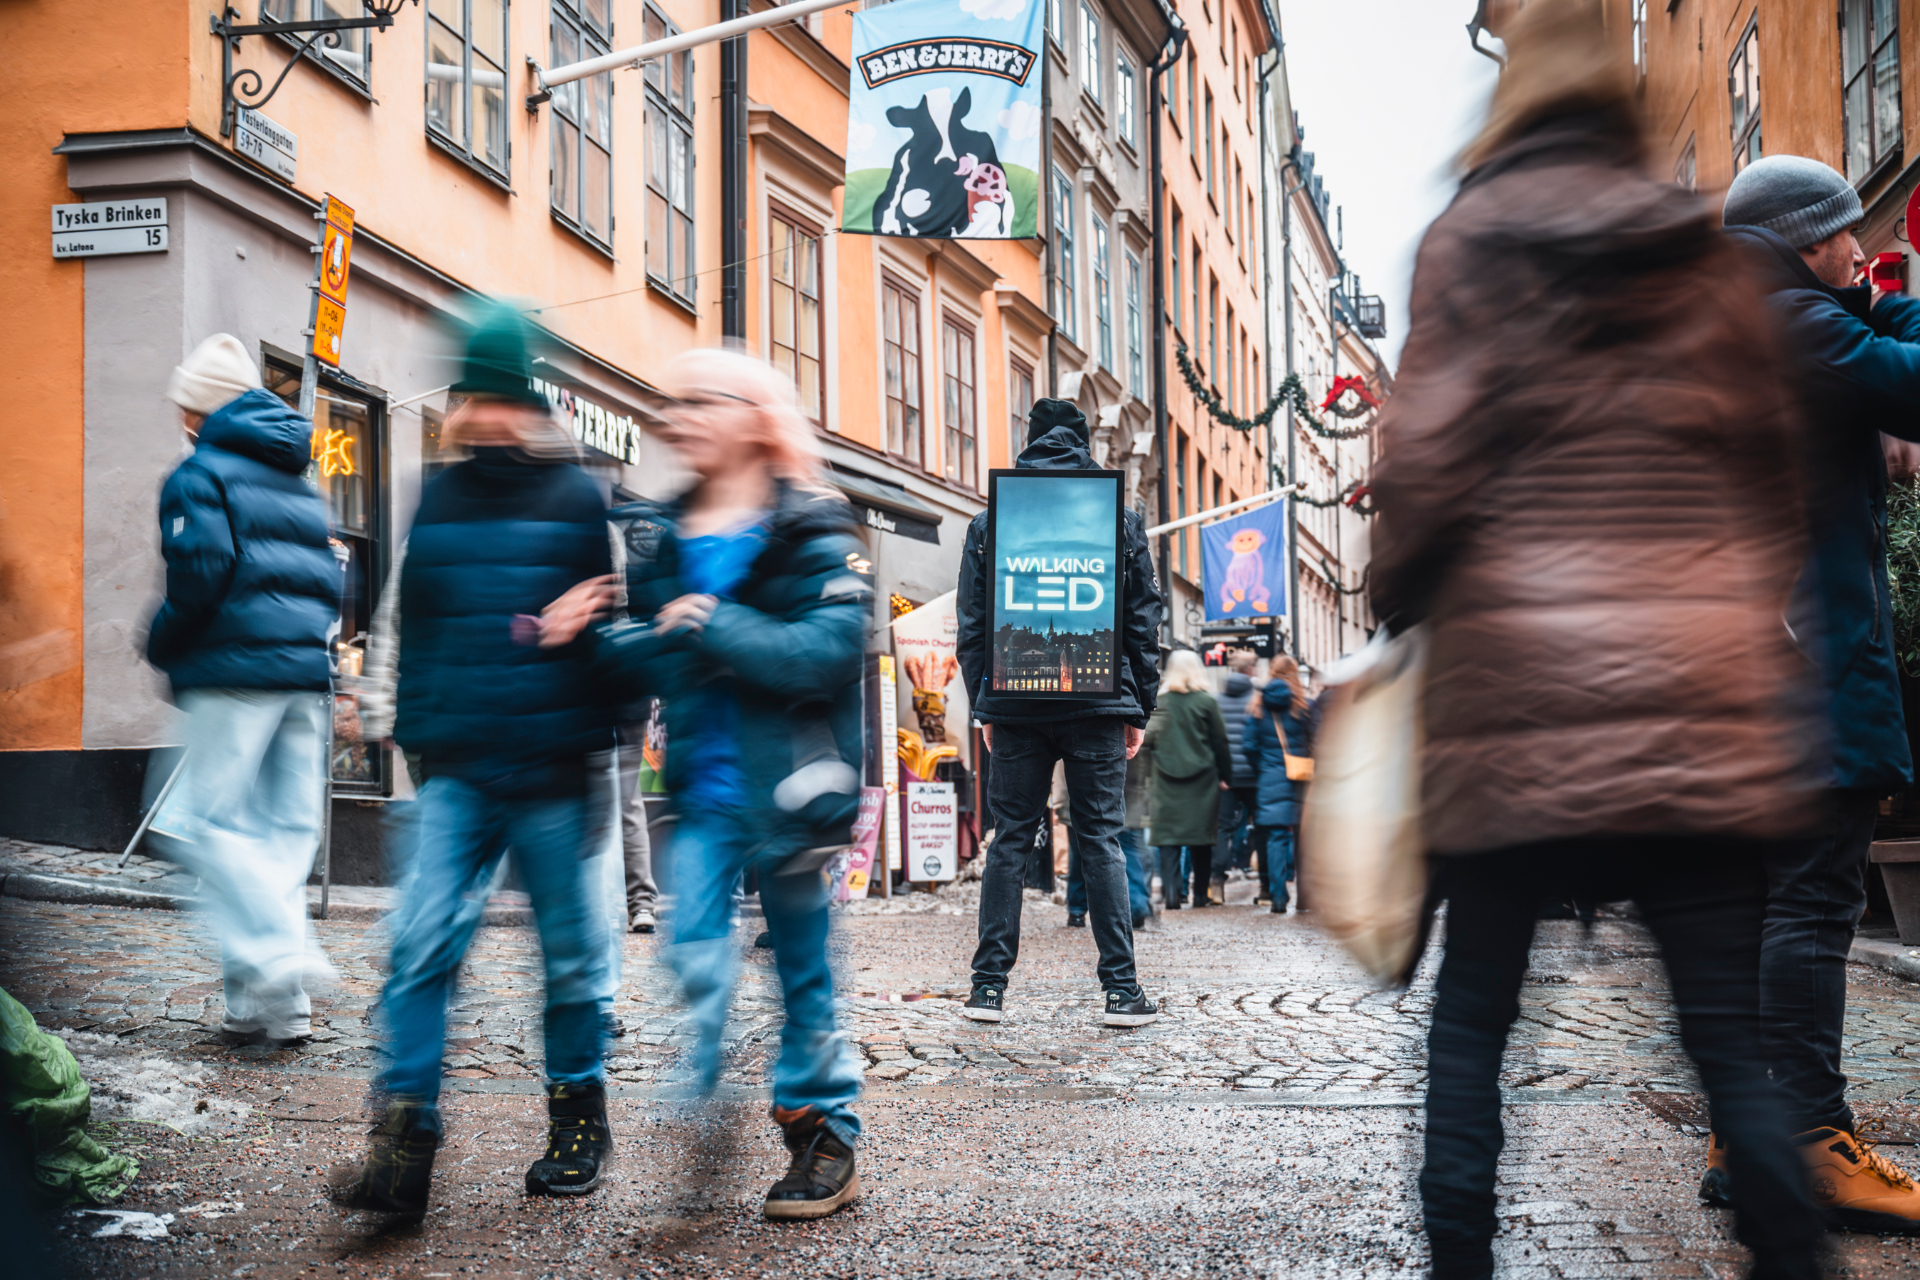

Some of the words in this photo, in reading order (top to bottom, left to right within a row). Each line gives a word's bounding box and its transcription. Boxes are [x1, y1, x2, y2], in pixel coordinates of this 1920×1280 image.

[240, 131, 263, 158] 59-79
[56, 208, 99, 228] Tyska
[106, 205, 161, 222] Brinken
[146, 229, 161, 246] 15
[57, 244, 68, 253] kv.
[70, 243, 94, 252] Latona
[324, 306, 338, 322] 11-06
[1006, 557, 1105, 573] WALKING
[1005, 576, 1104, 611] LED
[896, 636, 930, 646] Spanish
[911, 801, 952, 814] Churros
